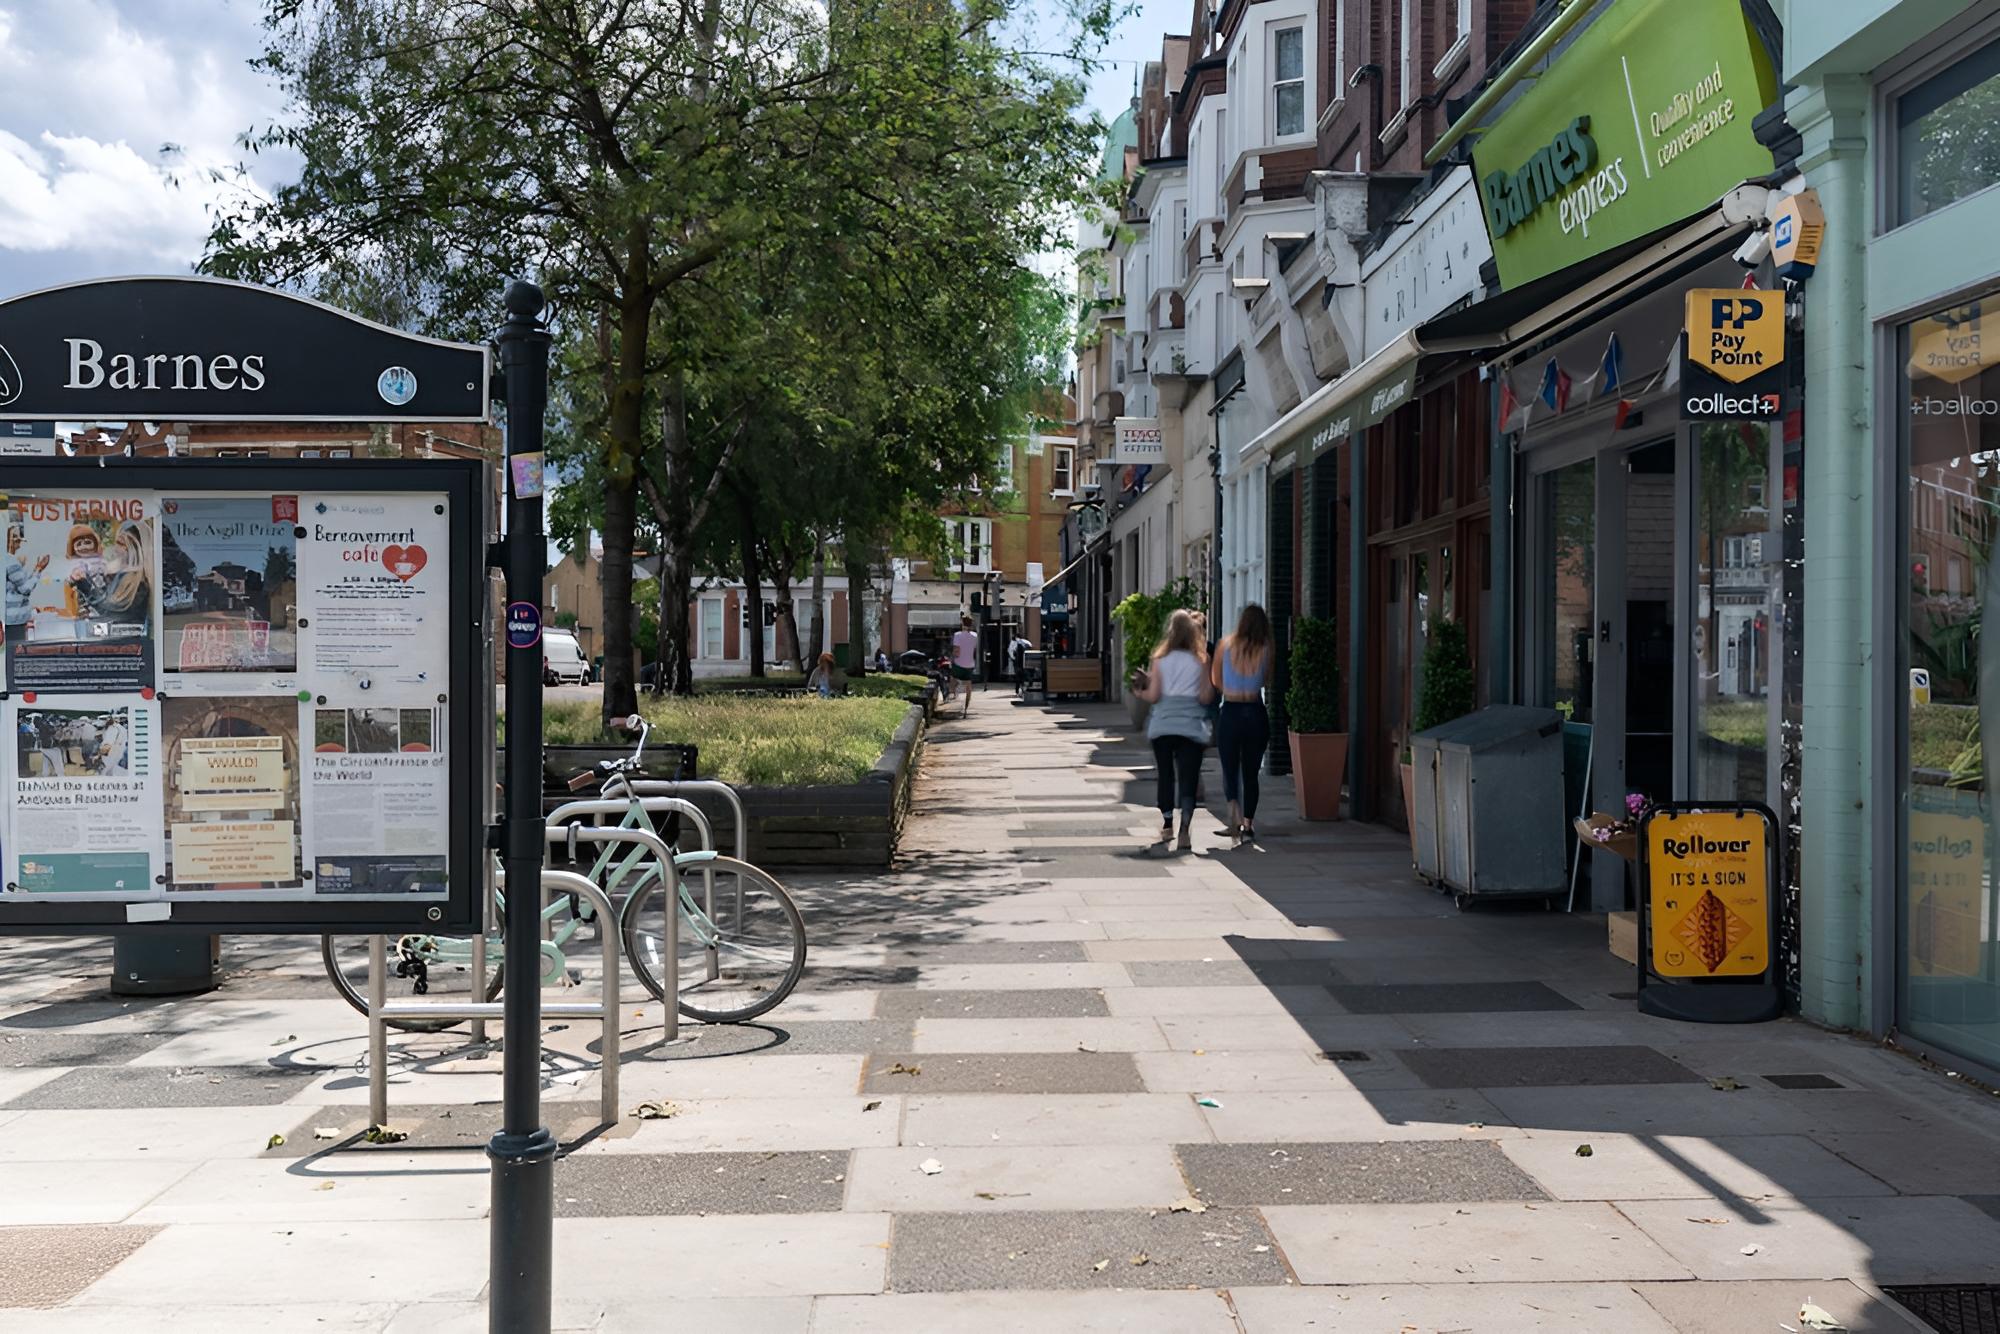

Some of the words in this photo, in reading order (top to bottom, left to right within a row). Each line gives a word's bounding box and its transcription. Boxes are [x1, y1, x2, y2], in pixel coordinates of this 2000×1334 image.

[1650, 87, 1694, 138] Quality
[1695, 60, 1724, 104] and
[1657, 97, 1735, 168] convenience
[1484, 115, 1598, 240] Barnes
[1559, 157, 1628, 239] express
[1711, 332, 1746, 352] Pay
[63, 338, 266, 391] Barnes
[1711, 350, 1764, 365] Point
[17, 499, 143, 521] FOSTERING
[315, 524, 414, 543] Bereavement
[1663, 834, 1751, 859] Rollover
[1670, 872, 1695, 886] IT'S
[1700, 872, 1710, 884] A
